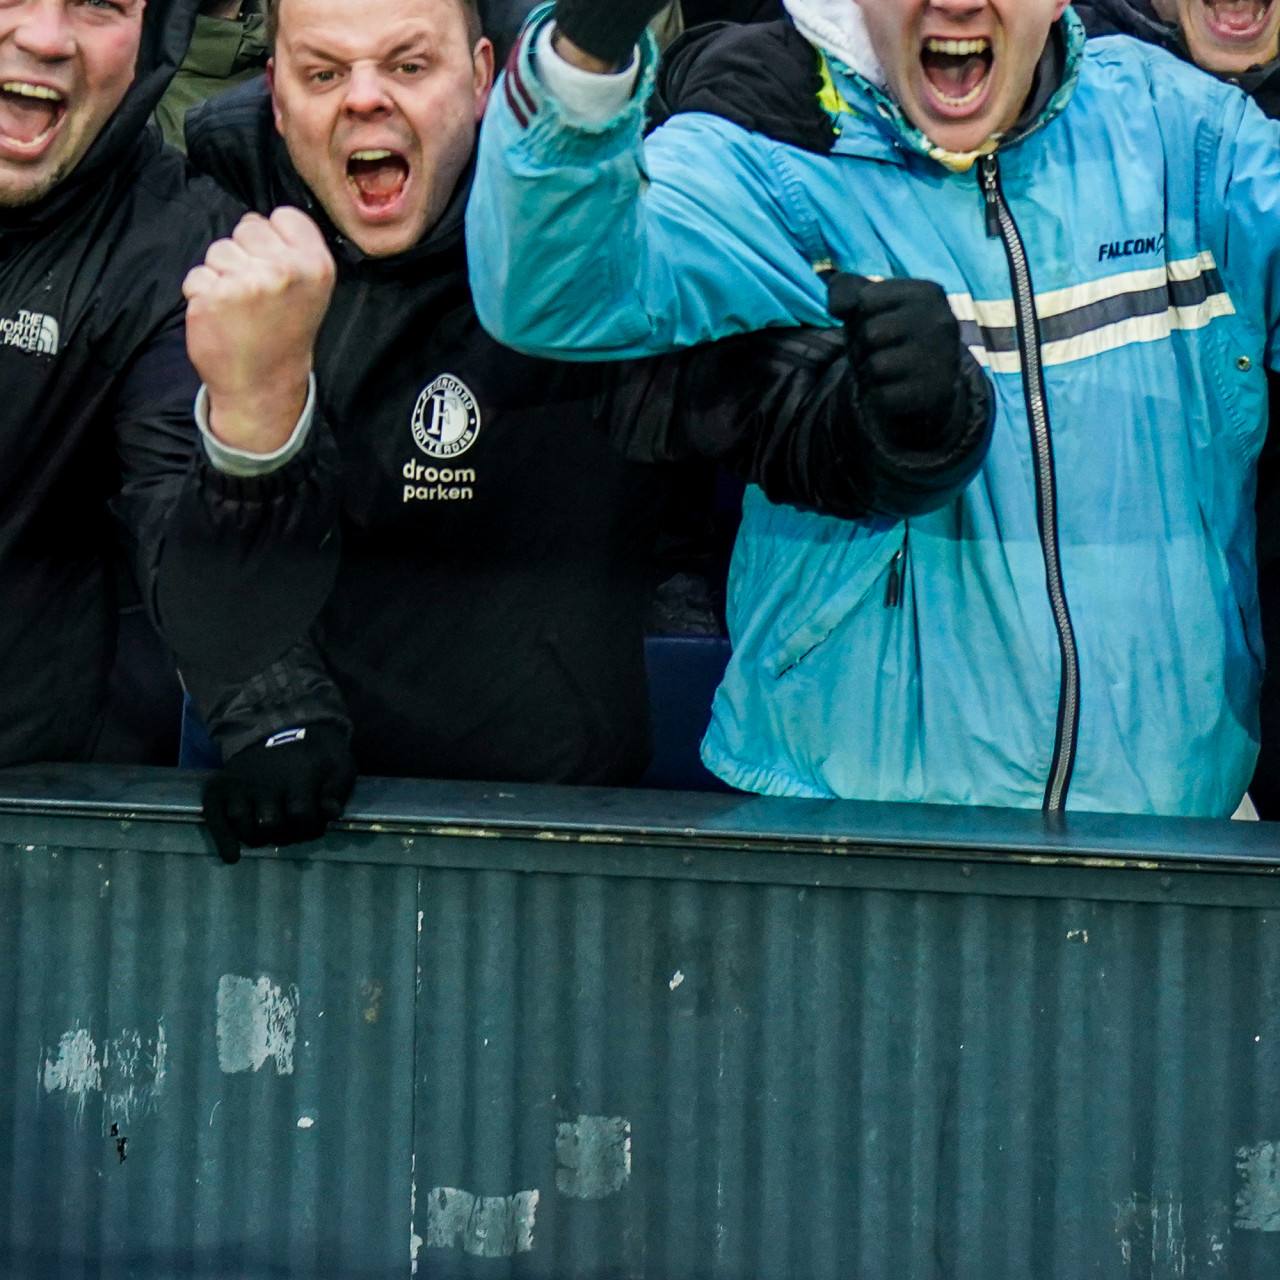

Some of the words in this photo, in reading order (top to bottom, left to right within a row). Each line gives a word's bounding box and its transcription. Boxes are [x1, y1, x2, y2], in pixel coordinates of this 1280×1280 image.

[1098, 236, 1156, 262] FALCON
[18, 309, 45, 327] THE
[3, 331, 38, 352] FACE
[402, 457, 476, 482] droom
[402, 483, 474, 503] parken
